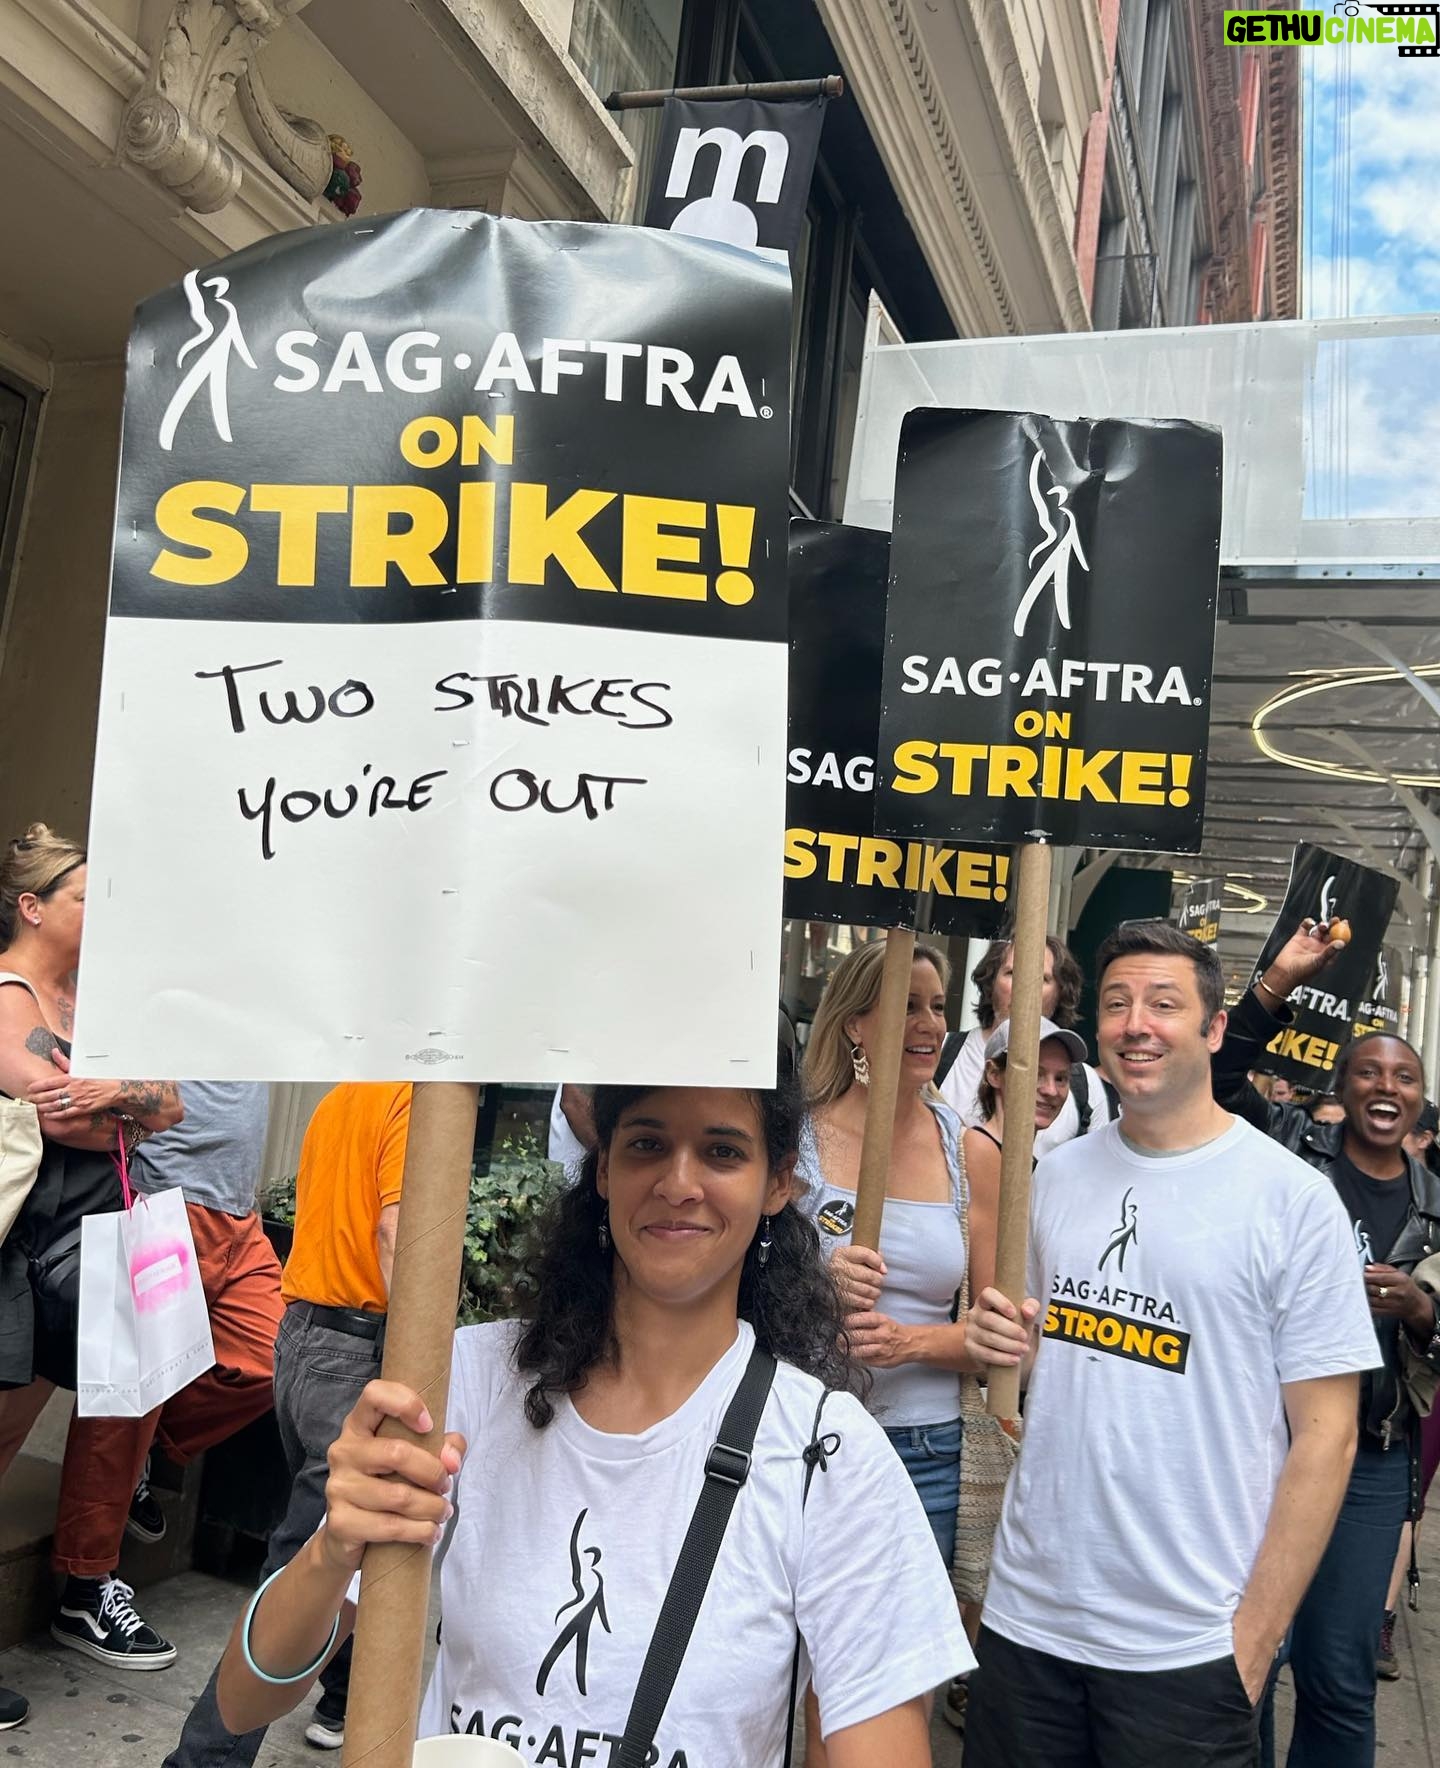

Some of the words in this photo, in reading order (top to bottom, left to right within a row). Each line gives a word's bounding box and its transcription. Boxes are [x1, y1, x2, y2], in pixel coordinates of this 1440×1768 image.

[399, 414, 515, 469] ON
[149, 481, 756, 606] STRIKE!
[434, 672, 674, 730] STRIKES
[1013, 710, 1071, 740] ON
[489, 769, 648, 821] OUT
[891, 740, 1194, 809] STRIKE!
[783, 828, 1010, 903] STRIKE!
[1043, 1304, 1182, 1365] STRONG
